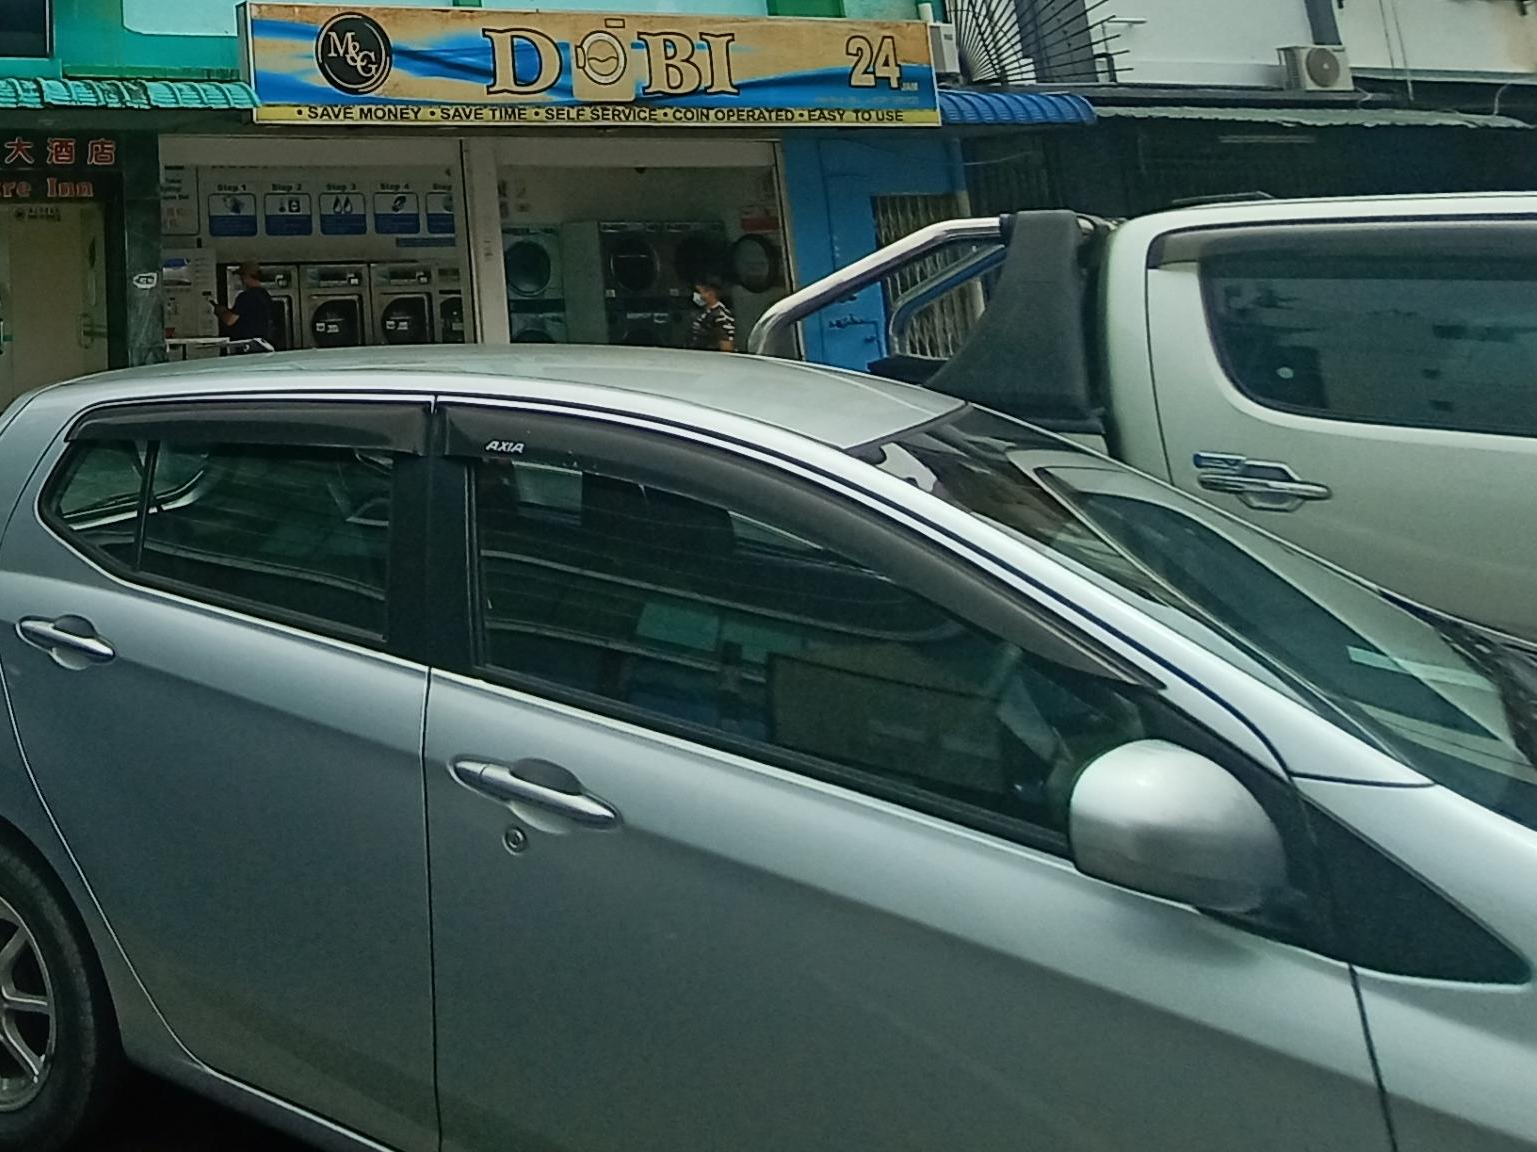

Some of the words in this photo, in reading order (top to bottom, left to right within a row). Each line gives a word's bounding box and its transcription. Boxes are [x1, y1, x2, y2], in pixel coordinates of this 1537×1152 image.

[327, 31, 378, 77] M&G
[845, 35, 902, 90] 24
[307, 106, 353, 120] SAVE
[359, 106, 421, 120] MONEY
[440, 107, 484, 120] SAVE
[490, 107, 527, 120] TIME
[545, 108, 585, 121] SELF
[590, 108, 657, 121] SERVICE
[673, 108, 710, 121] COIN
[714, 108, 795, 122] OPERATED
[808, 109, 845, 121] EASY
[854, 109, 872, 122] TO
[877, 109, 903, 122] USE
[46, 177, 94, 197] Inn
[485, 440, 524, 453] AXIA
